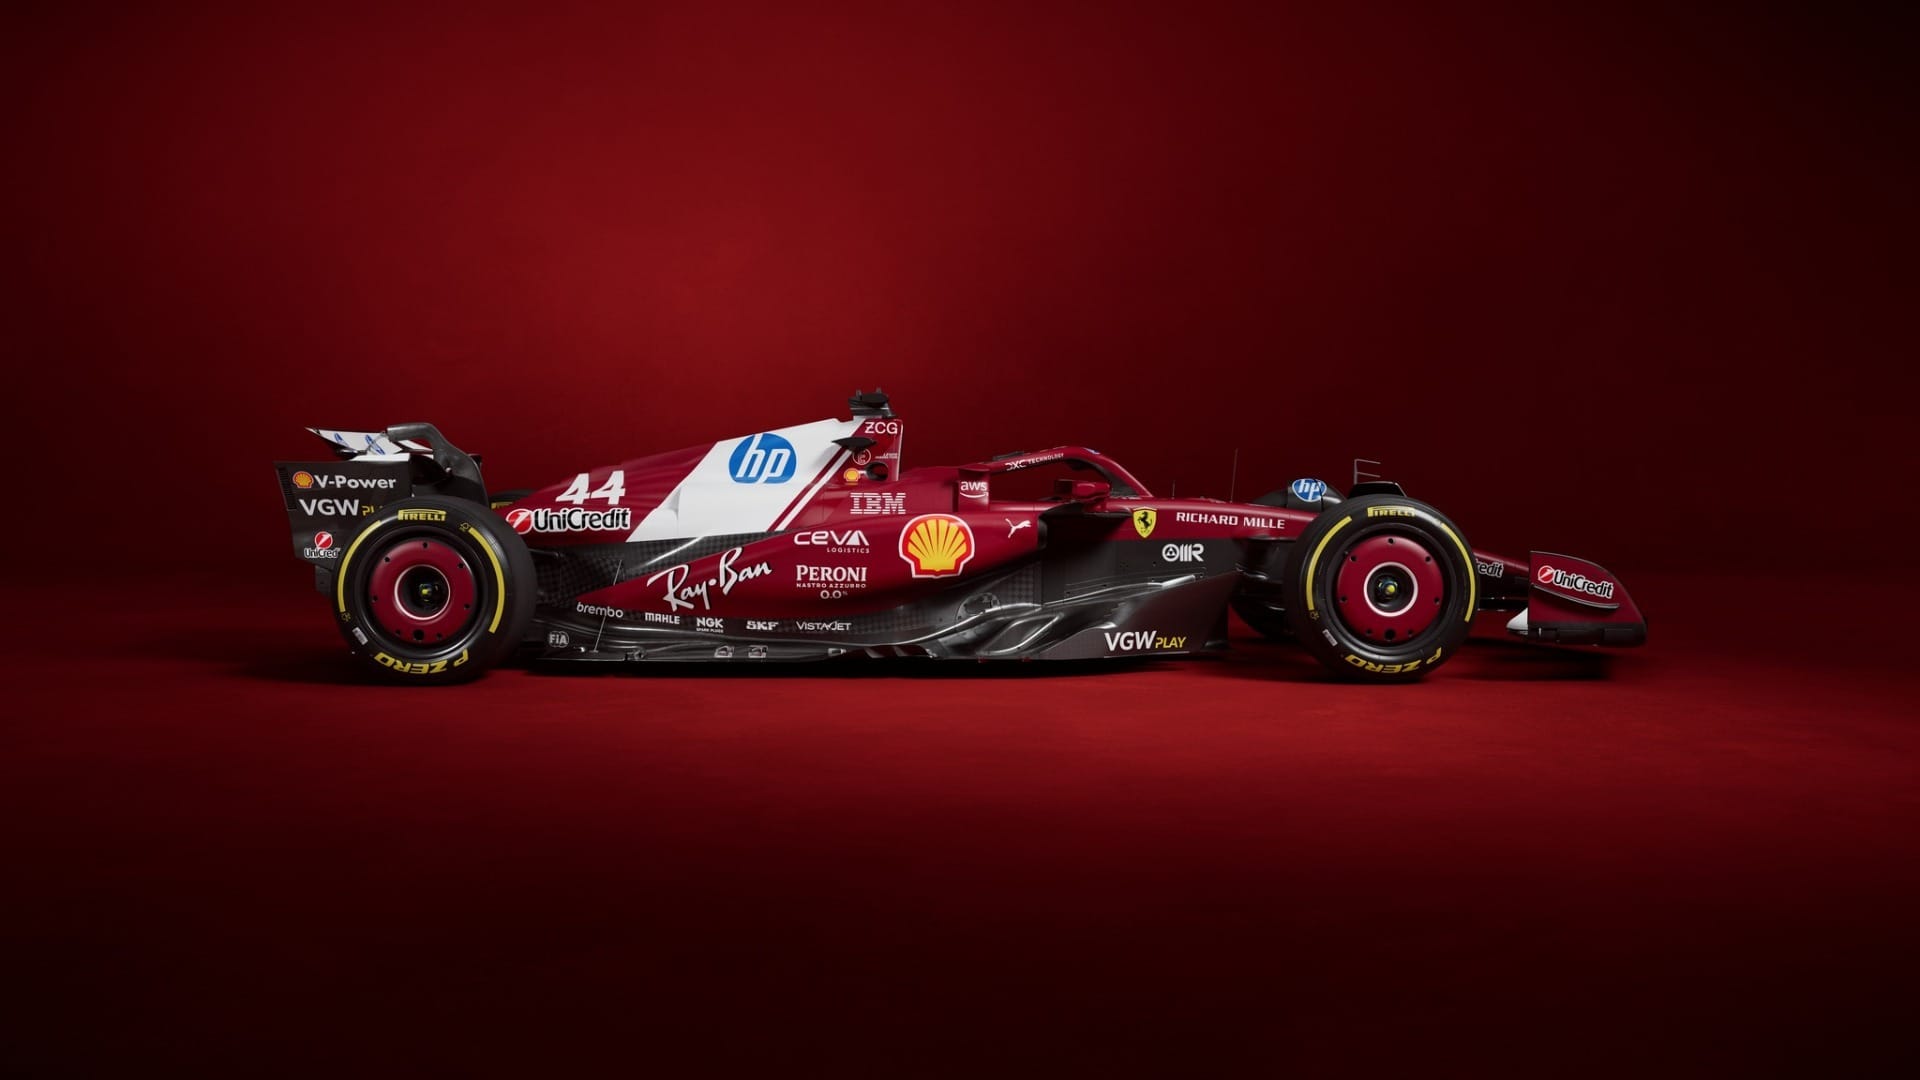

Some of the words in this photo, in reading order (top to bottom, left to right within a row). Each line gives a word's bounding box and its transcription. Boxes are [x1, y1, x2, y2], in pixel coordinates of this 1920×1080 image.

[864, 421, 898, 434] ZCG
[736, 433, 791, 486] hp
[1028, 453, 1064, 464] TECHNOLOGY
[314, 475, 396, 489] V-Power
[556, 470, 626, 505] 44
[960, 481, 988, 491] aws
[299, 499, 359, 516] VGW
[850, 492, 906, 515] IBM
[1367, 505, 1416, 518] PIRELLI
[397, 508, 447, 521] PIRELLI
[533, 508, 630, 531] UniCredit
[1176, 512, 1238, 525] RICHARD
[1243, 517, 1285, 529] MILLE
[304, 547, 339, 558] UniCred
[796, 565, 867, 582] PERONI
[1553, 570, 1614, 599] UniCredit
[576, 602, 624, 618] brembo
[645, 612, 681, 625] MAHLE
[696, 617, 723, 628] NGK
[746, 620, 779, 630] SKF
[1104, 630, 1157, 651] VGW
[1155, 636, 1187, 649] PLAY
[374, 652, 448, 674] ZERO
[453, 649, 469, 667] P
[1426, 646, 1442, 664] P
[1345, 654, 1420, 674] ZERO
